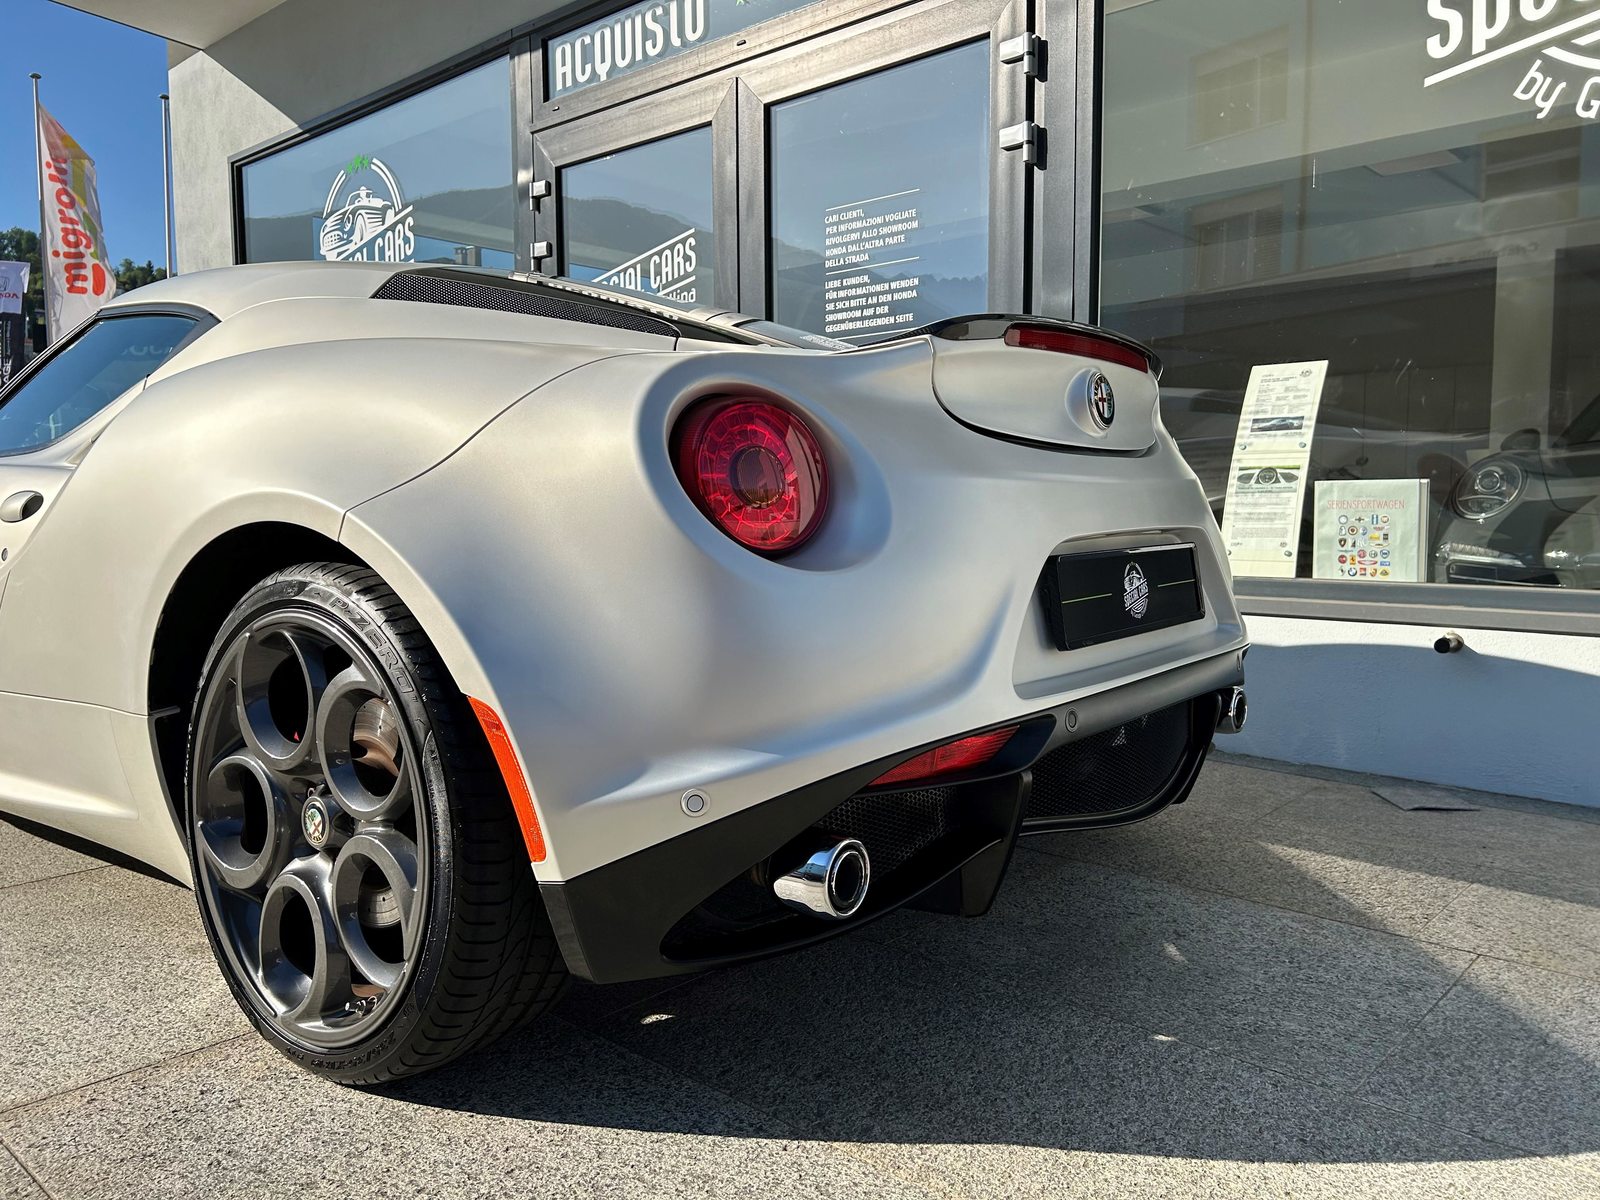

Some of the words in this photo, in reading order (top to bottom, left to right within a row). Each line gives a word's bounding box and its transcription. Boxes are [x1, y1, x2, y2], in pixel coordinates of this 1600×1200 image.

[1512, 59, 1567, 119] by
[825, 215, 839, 224] CARI
[840, 208, 865, 221] CLIENTI,
[825, 225, 837, 235] PER
[838, 215, 884, 232] INFORMAZIONI
[885, 208, 917, 222] VOGLIATE
[825, 232, 860, 246] RIVOLGERVI
[861, 228, 878, 239] ALLO
[879, 219, 919, 235] SHOWROOM
[825, 245, 847, 257] HONDA
[885, 234, 906, 246] PARTE
[650, 237, 696, 289] CARS
[825, 257, 844, 268] DELLA
[845, 252, 870, 265] STRADA
[825, 279, 842, 289] LIEBE
[842, 274, 871, 287] KUNDEN,
[825, 290, 838, 300] FÜR
[838, 282, 889, 298] INFORMATIONEN
[890, 277, 919, 290] WENDEN
[825, 303, 835, 311] SIE
[835, 300, 850, 310] SICH
[850, 297, 867, 308] BITTE
[867, 296, 877, 305] AN
[878, 293, 892, 303] DEN
[893, 289, 917, 301] HONDA
[825, 309, 862, 322] SHOWROOM
[862, 307, 875, 317] AUF
[875, 305, 889, 315] DER
[825, 315, 895, 333] GEGENÜBERLIEGENDEN
[895, 312, 914, 323] SEITE
[1327, 499, 1405, 510] SERIENSPORTWAGEN
